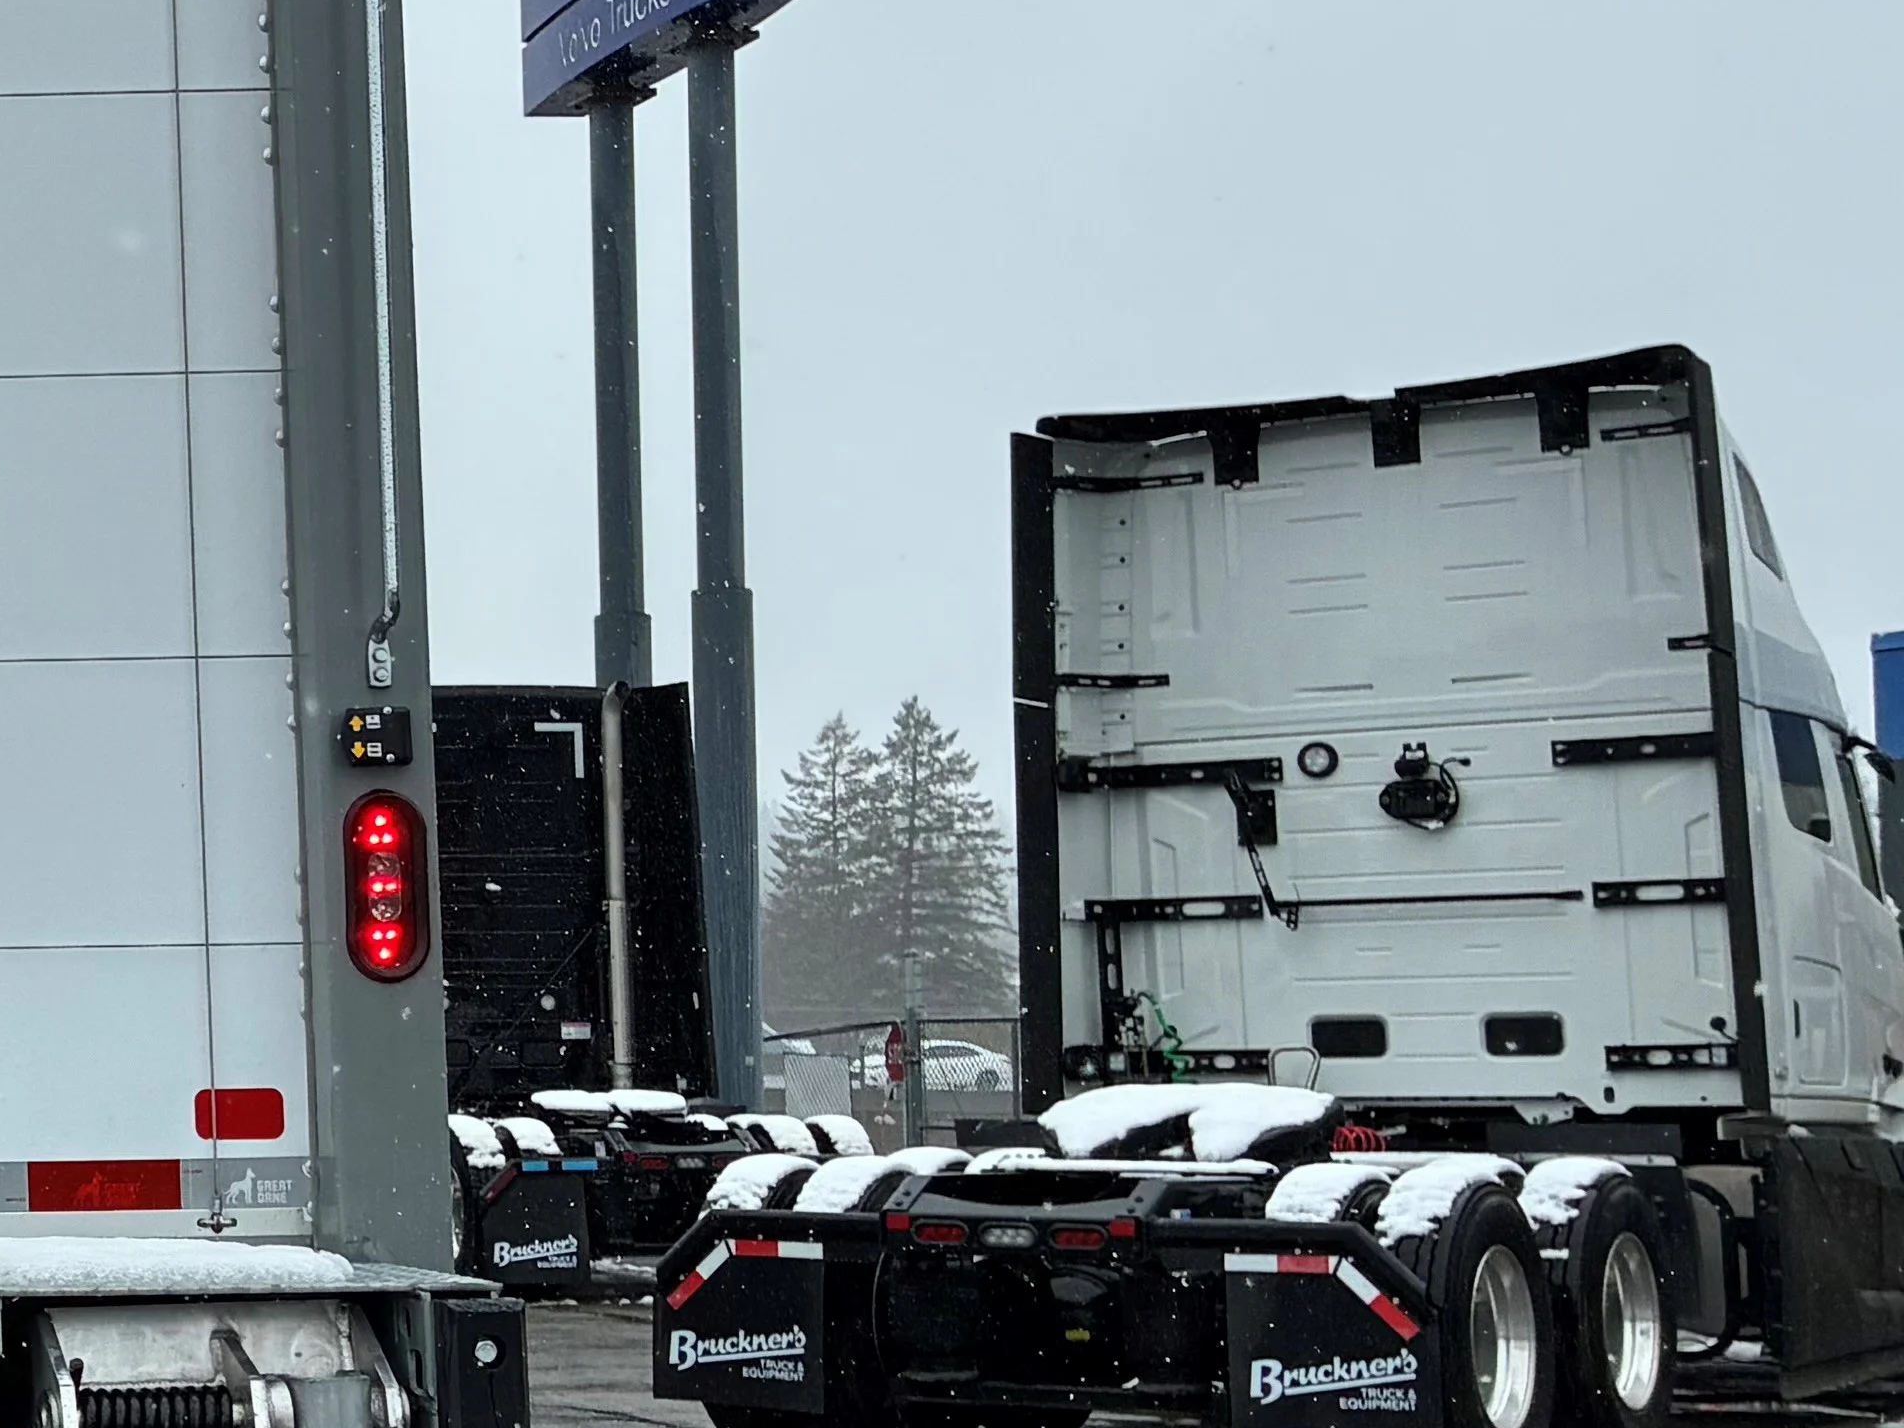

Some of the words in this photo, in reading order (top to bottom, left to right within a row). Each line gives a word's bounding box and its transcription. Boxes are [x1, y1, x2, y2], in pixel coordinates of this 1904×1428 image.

[257, 1180, 293, 1192] GREAT
[493, 1233, 578, 1267] Bruckner's
[669, 1324, 807, 1371] Bruckner's
[1250, 1347, 1418, 1405] Bruckner's
[1339, 1397, 1417, 1411] EQUIPMENT
[1360, 1387, 1405, 1399] TRUCK
